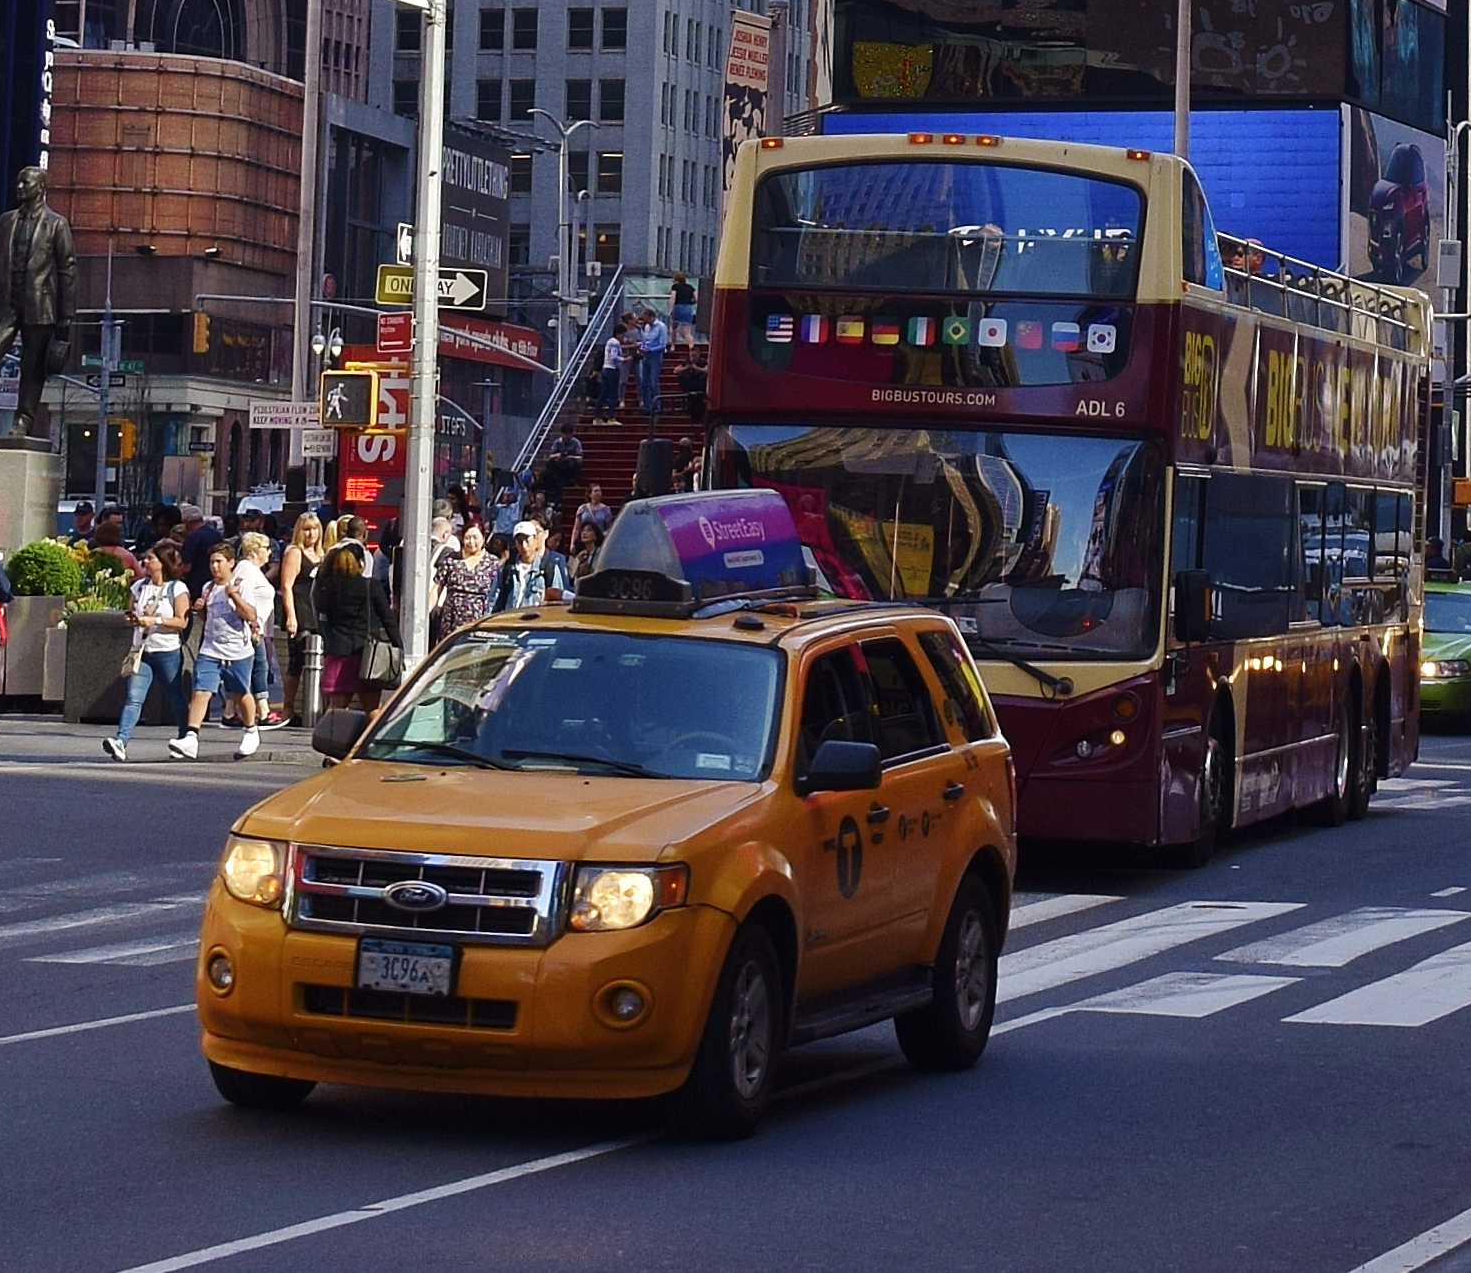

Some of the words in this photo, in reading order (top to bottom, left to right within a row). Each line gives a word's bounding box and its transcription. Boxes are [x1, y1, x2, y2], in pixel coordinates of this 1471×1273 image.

[871, 387, 997, 407] BIGBUSTOURS.COM
[1075, 398, 1112, 418] ADL
[1114, 400, 1126, 418] 6
[713, 515, 766, 544] StreetEasy
[608, 577, 653, 602] 3C96
[401, 886, 431, 903] Ford
